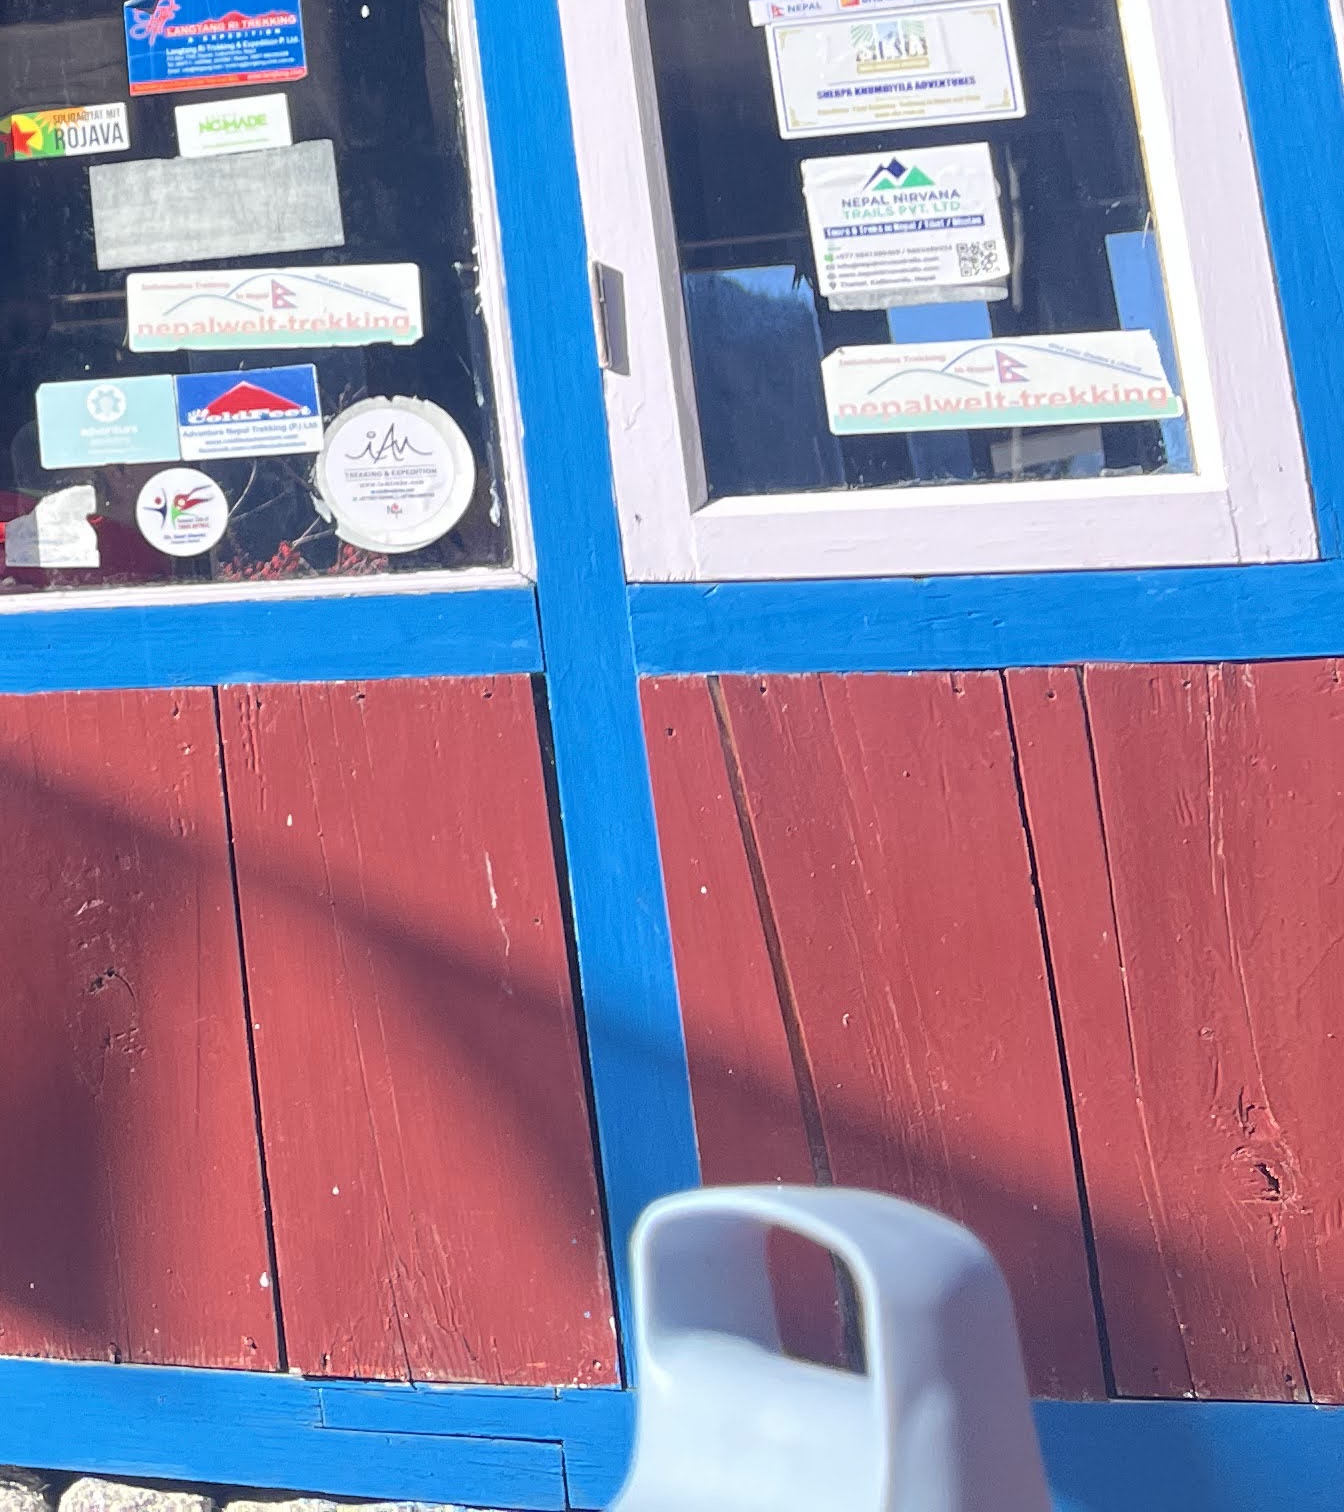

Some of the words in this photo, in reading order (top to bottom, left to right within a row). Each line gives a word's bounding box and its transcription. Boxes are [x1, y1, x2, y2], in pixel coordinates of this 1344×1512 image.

[787, 1, 822, 13] NEPAL
[166, 21, 226, 37] LANGTANG
[242, 15, 297, 28] TREKKING
[55, 122, 124, 150] ROJAVA
[842, 196, 889, 208] NEPAL
[893, 189, 961, 204] NIRVANA
[843, 206, 894, 220] TRAILS
[934, 200, 961, 212] LTD
[137, 311, 411, 341] nepalwelt-trekking
[838, 383, 1169, 420] nepalwelt-trekking
[182, 427, 225, 438] Adventure
[226, 426, 250, 437] Nepal
[252, 423, 287, 434] Trekking
